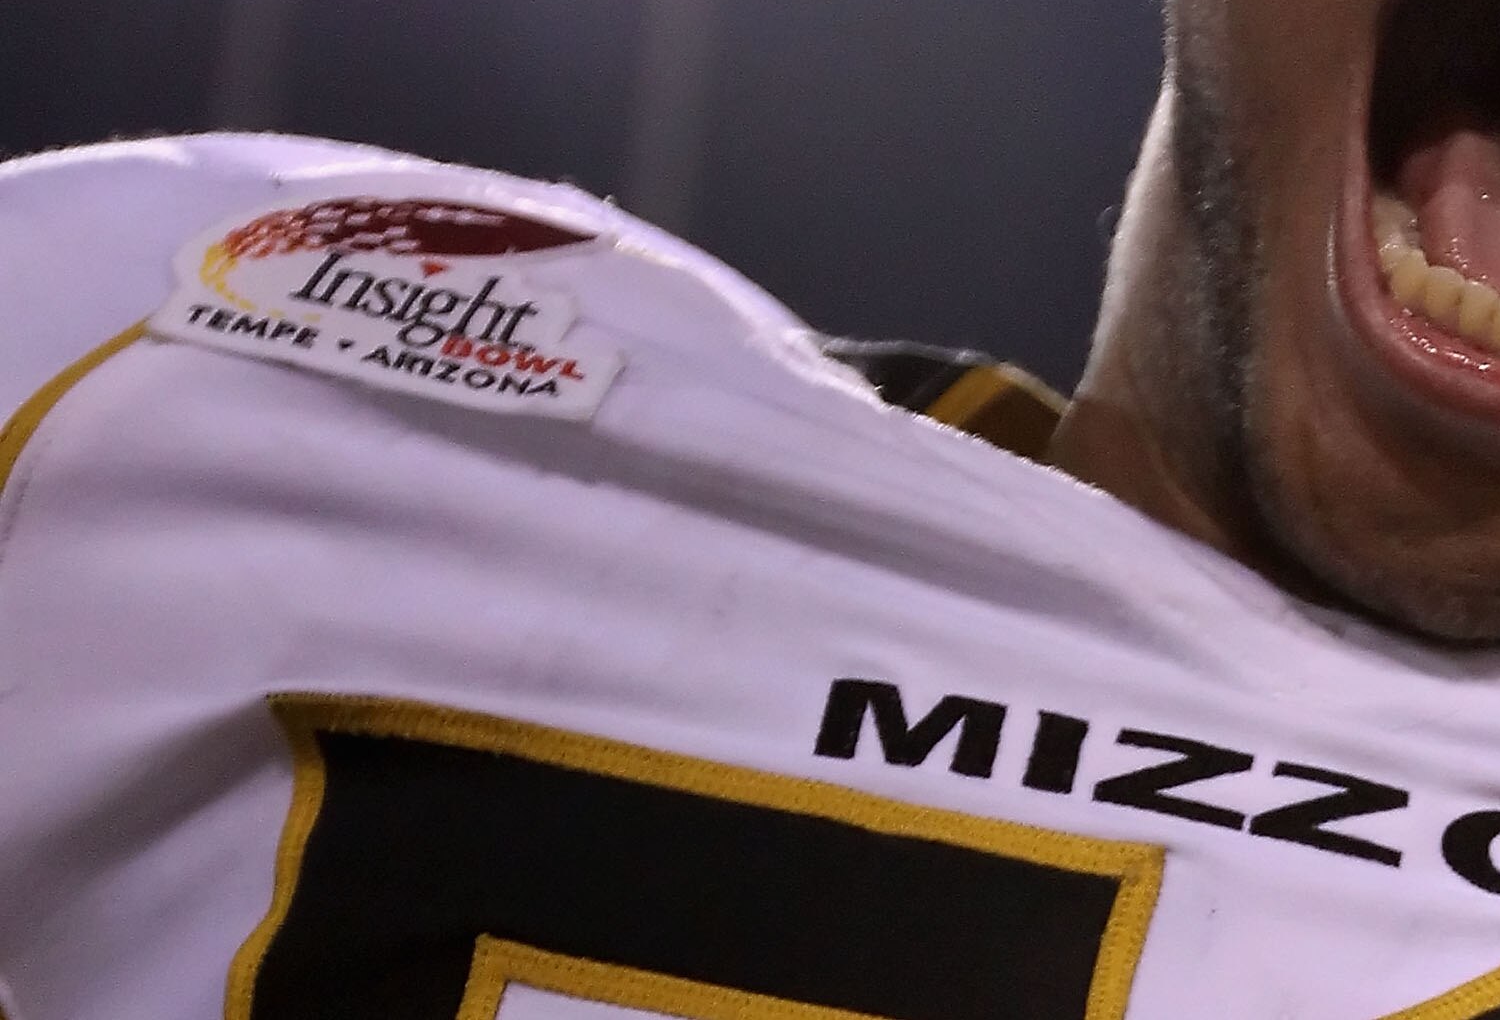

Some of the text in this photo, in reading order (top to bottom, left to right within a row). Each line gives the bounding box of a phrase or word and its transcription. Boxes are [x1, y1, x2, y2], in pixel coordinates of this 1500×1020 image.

[289, 252, 539, 352] Insight
[187, 304, 560, 396] TEMPE ARIZONA
[440, 335, 584, 380] BOWL
